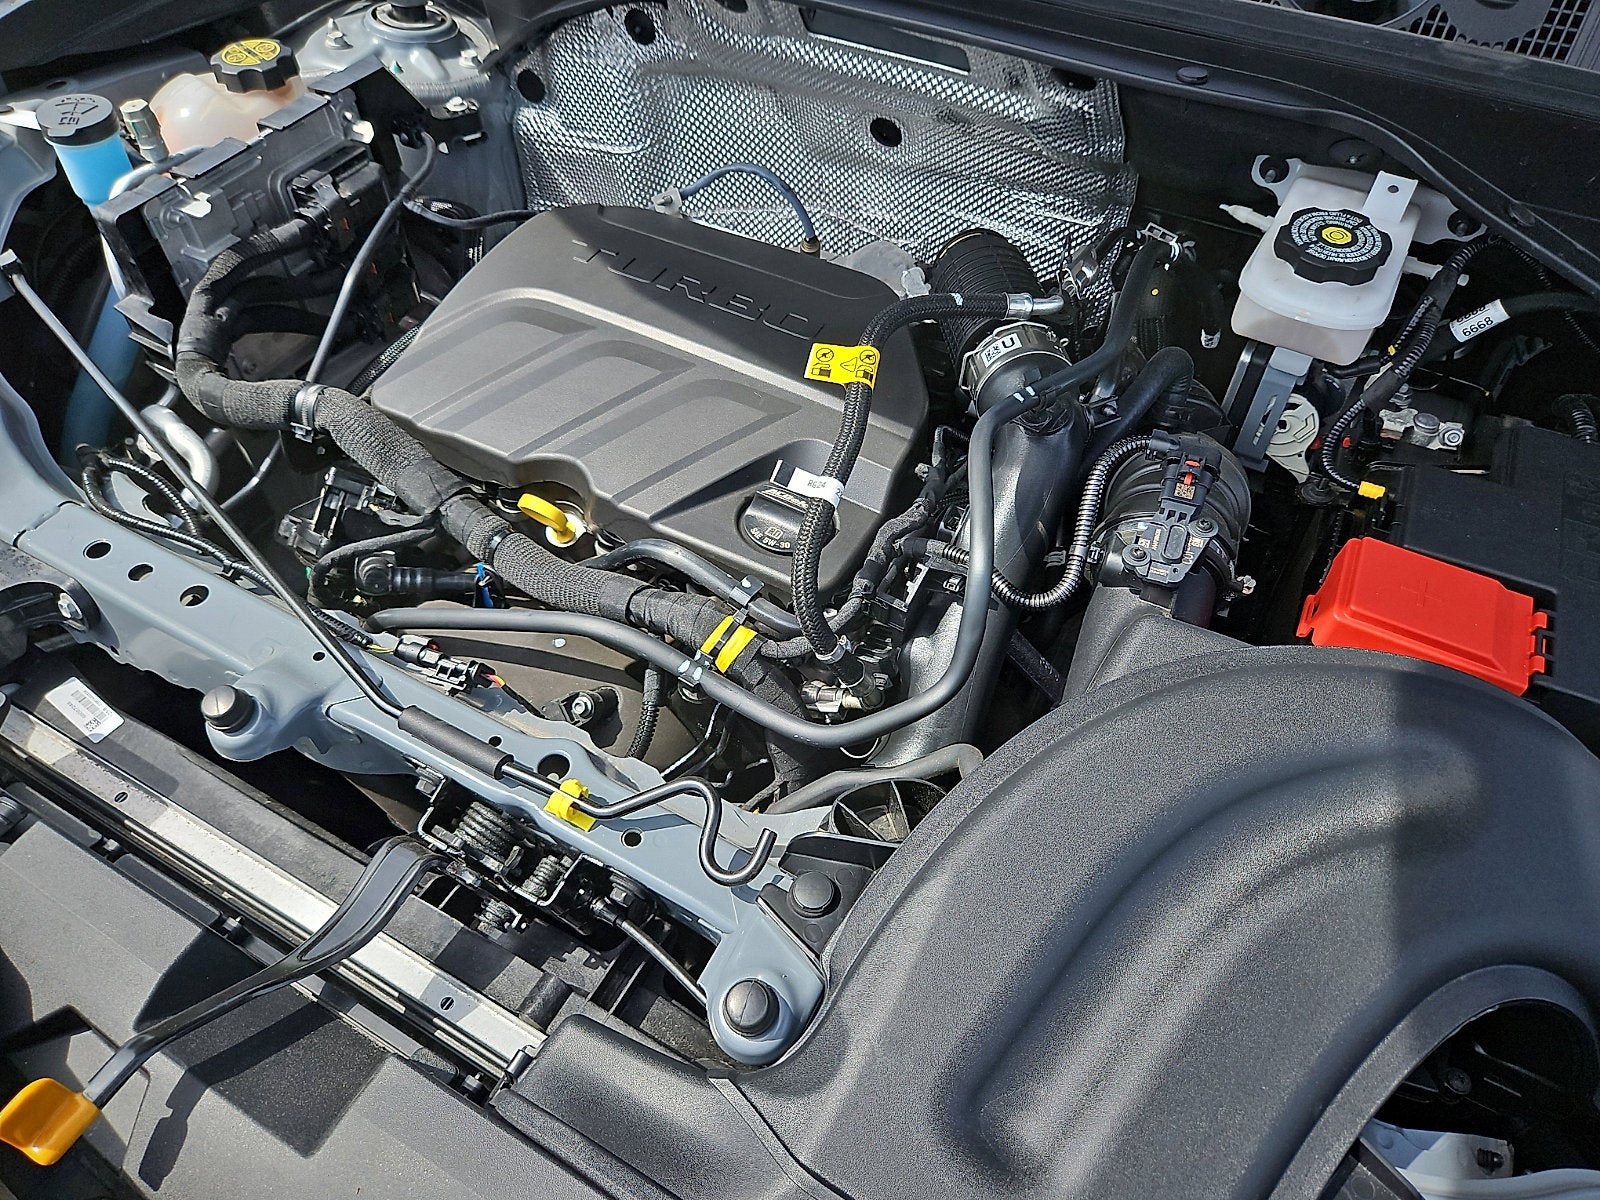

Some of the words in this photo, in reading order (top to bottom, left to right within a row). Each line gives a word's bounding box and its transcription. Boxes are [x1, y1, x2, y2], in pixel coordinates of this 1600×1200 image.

[571, 240, 825, 340] TURBO
[1462, 317, 1494, 337] 6668
[1001, 337, 1015, 348] U
[750, 527, 763, 540] SAE
[762, 536, 791, 549] 5W-30
